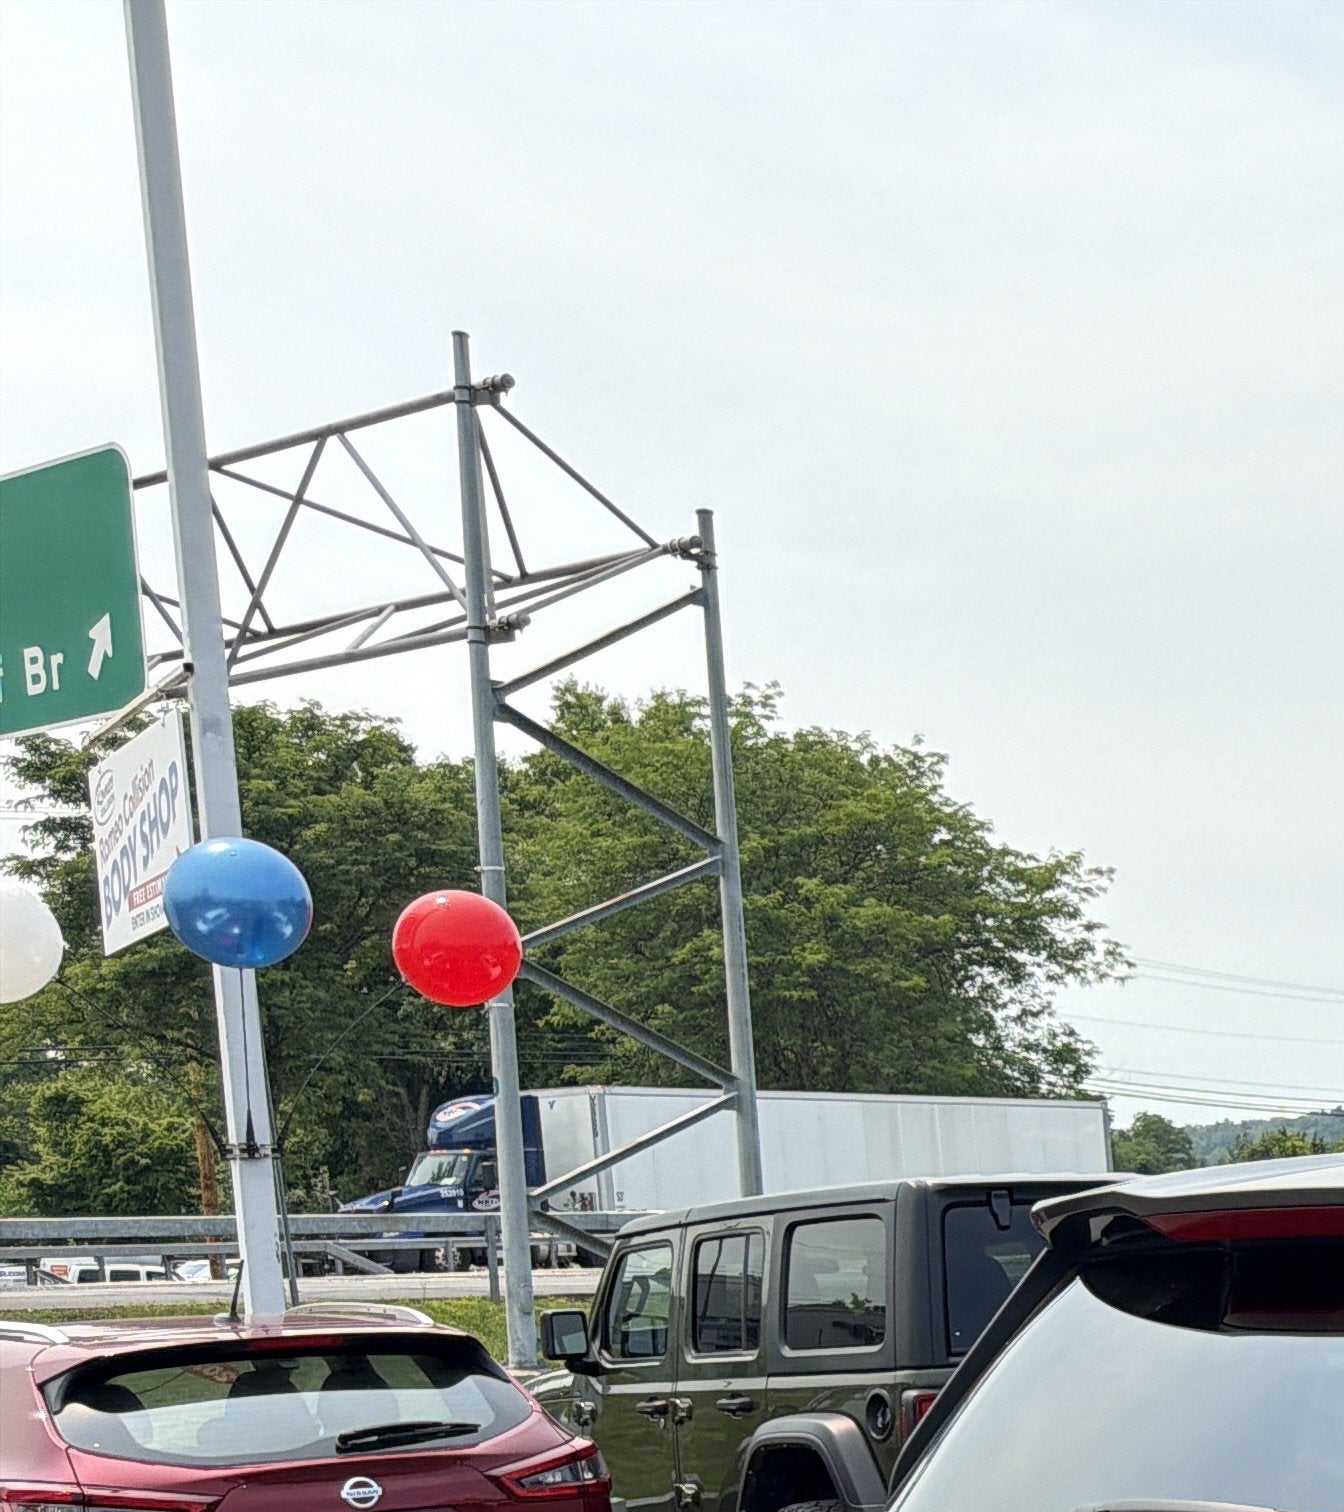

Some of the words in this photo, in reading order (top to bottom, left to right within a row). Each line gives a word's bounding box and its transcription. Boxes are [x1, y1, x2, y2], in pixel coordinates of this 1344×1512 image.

[23, 646, 64, 696] Br
[103, 824, 138, 931] BODY
[140, 760, 179, 871] SHOP
[345, 1489, 379, 1497] NISSAN
